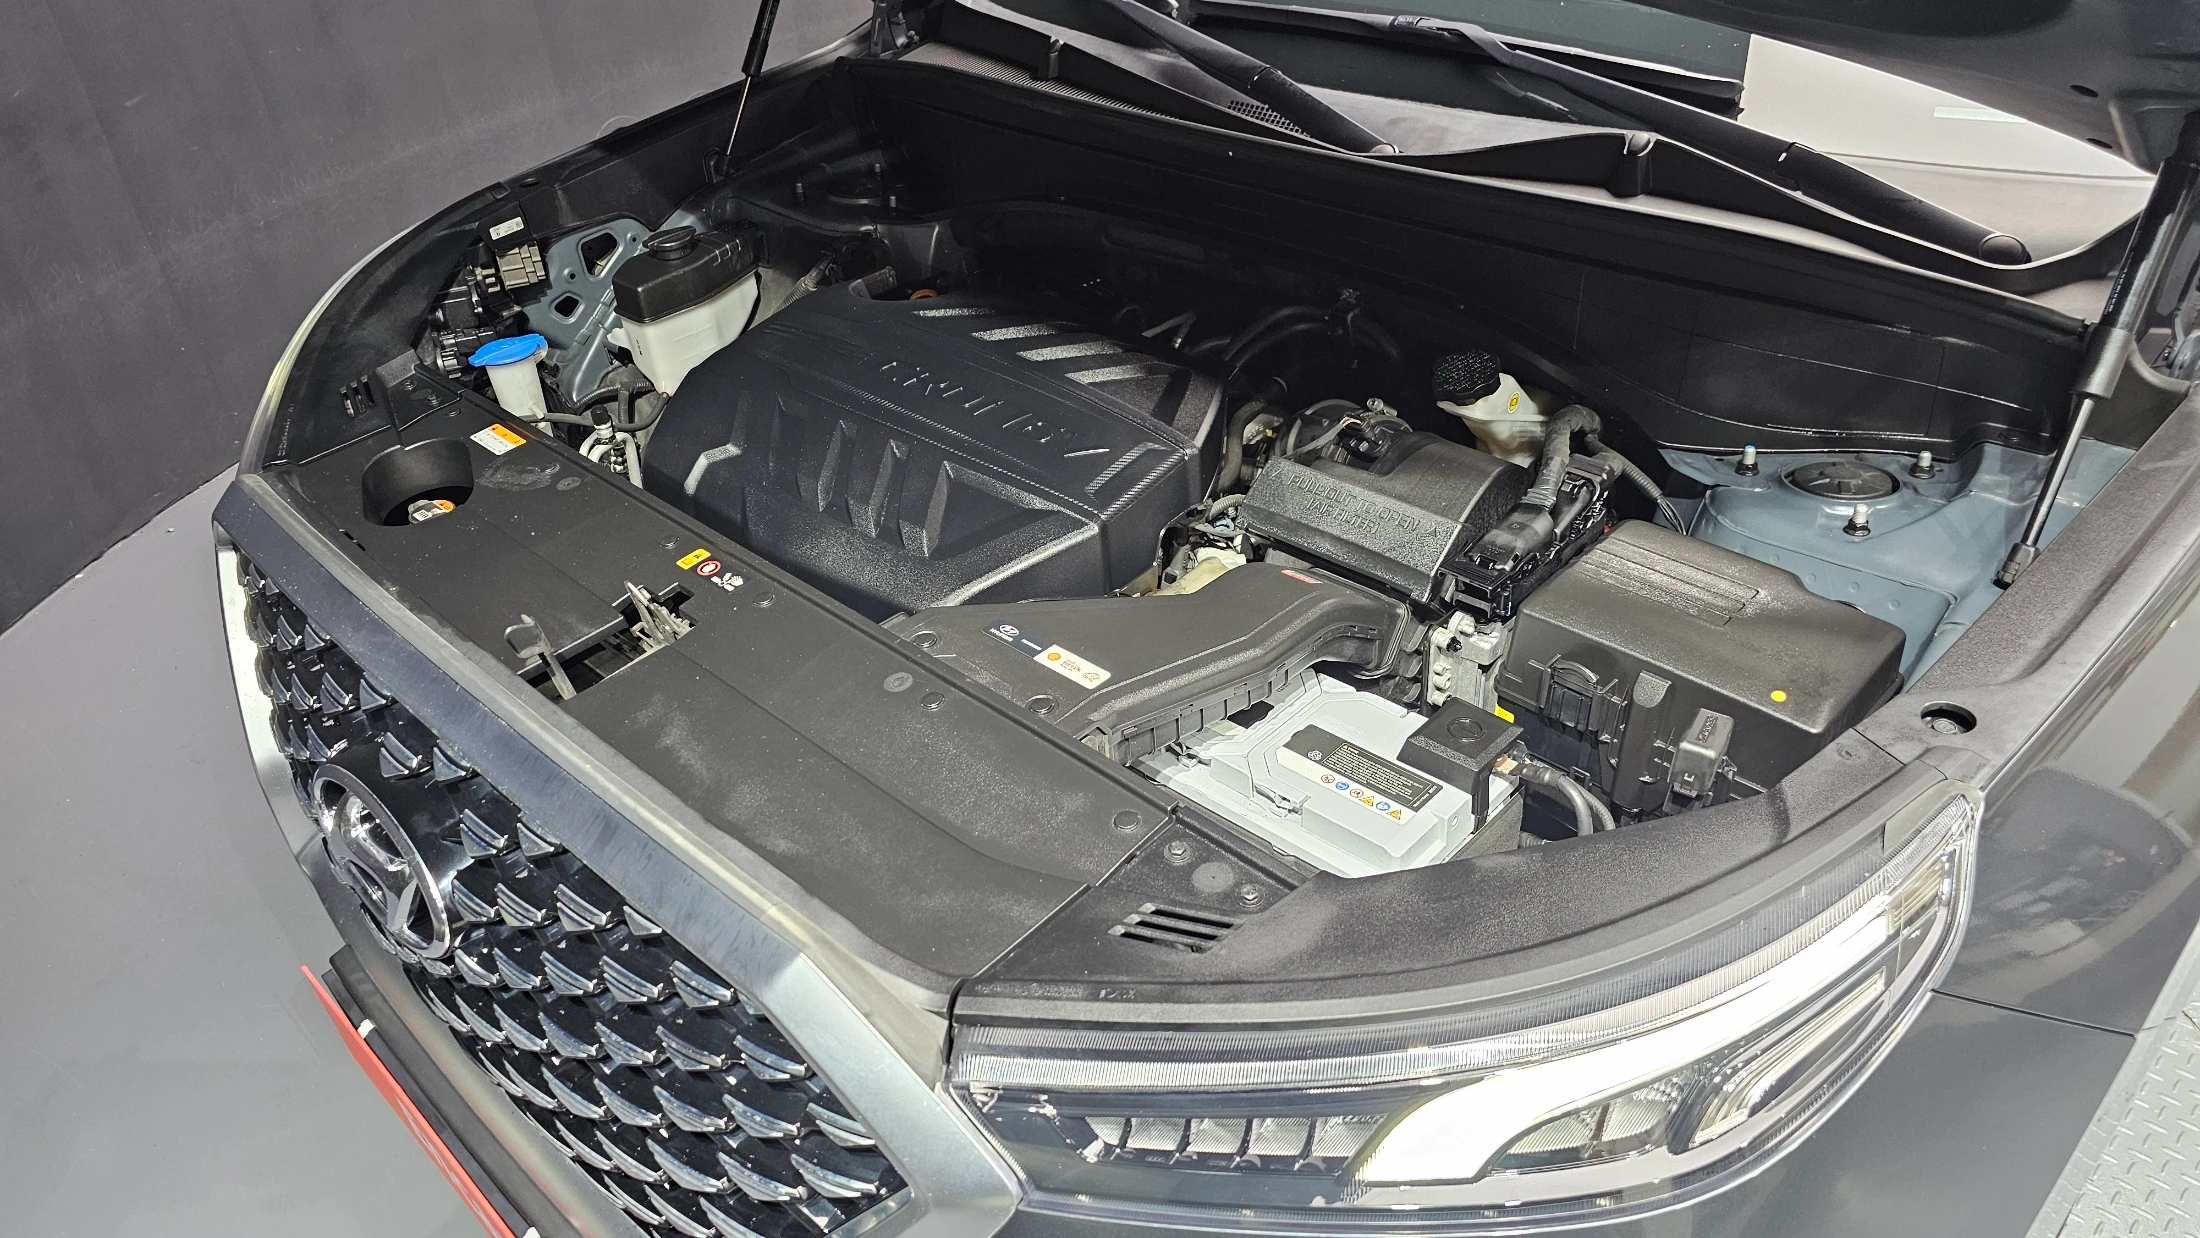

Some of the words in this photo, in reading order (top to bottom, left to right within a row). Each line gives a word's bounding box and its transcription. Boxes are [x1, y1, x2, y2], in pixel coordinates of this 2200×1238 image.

[1324, 487, 1356, 506] OUT
[1356, 498, 1377, 514] TO
[1376, 507, 1421, 531] OPEN
